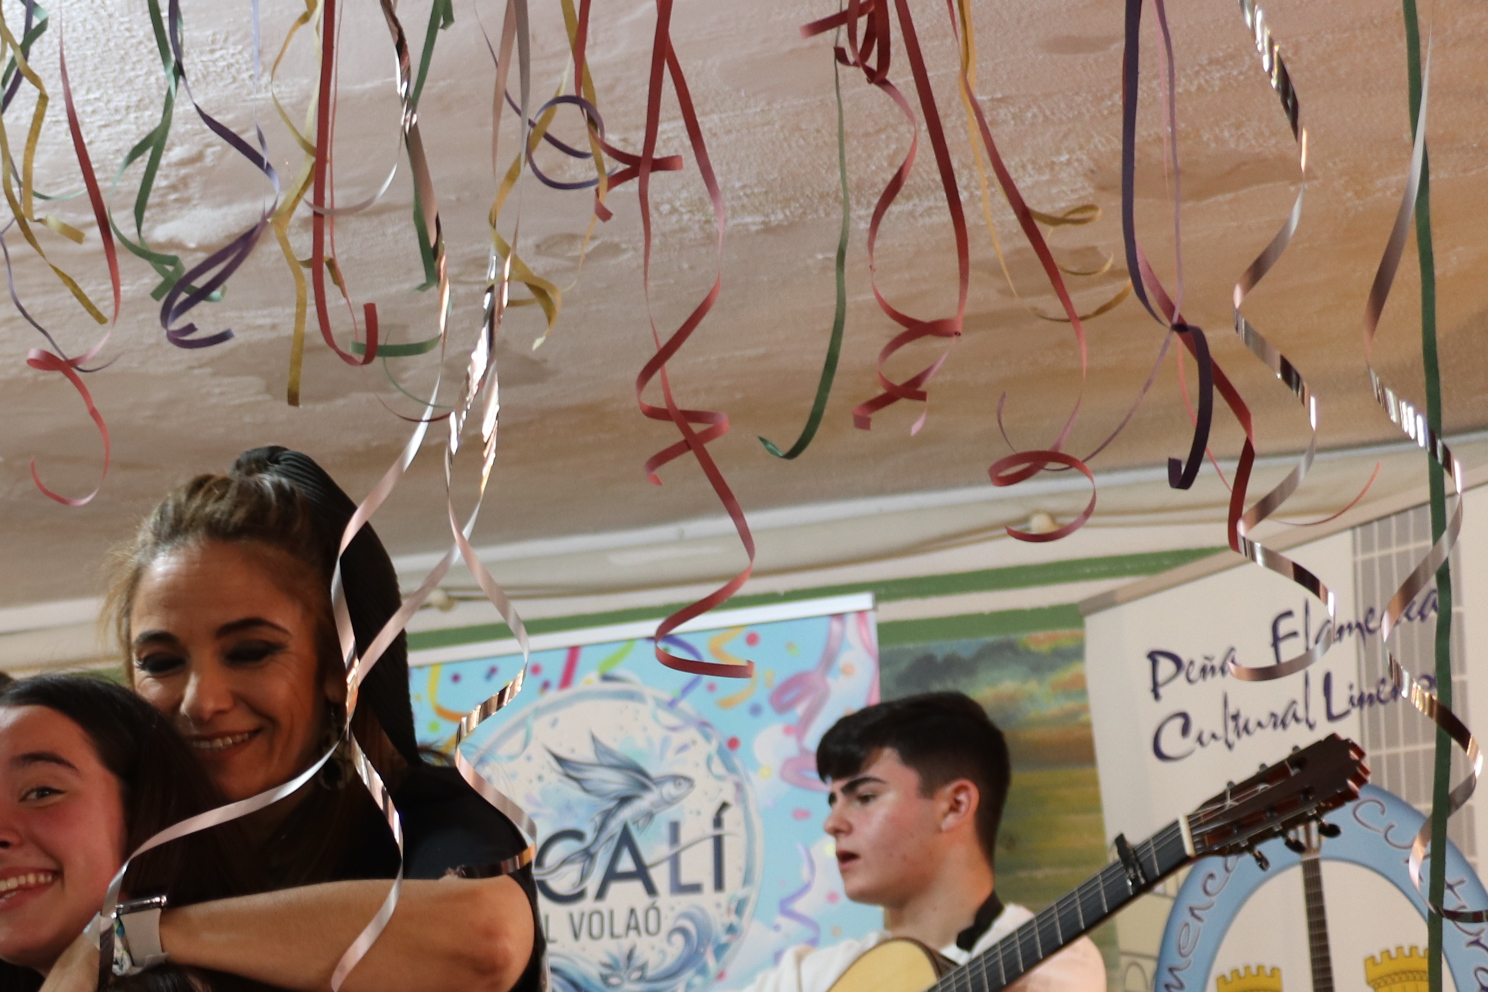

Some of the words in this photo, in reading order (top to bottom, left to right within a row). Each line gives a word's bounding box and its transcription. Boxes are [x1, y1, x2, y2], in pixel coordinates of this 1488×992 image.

[1147, 646, 1238, 702] Peña
[1270, 588, 1439, 664] Flameca
[1153, 669, 1317, 762] Cultural
[534, 800, 731, 906] CALÍ
[569, 902, 662, 942] VOLAÓ
